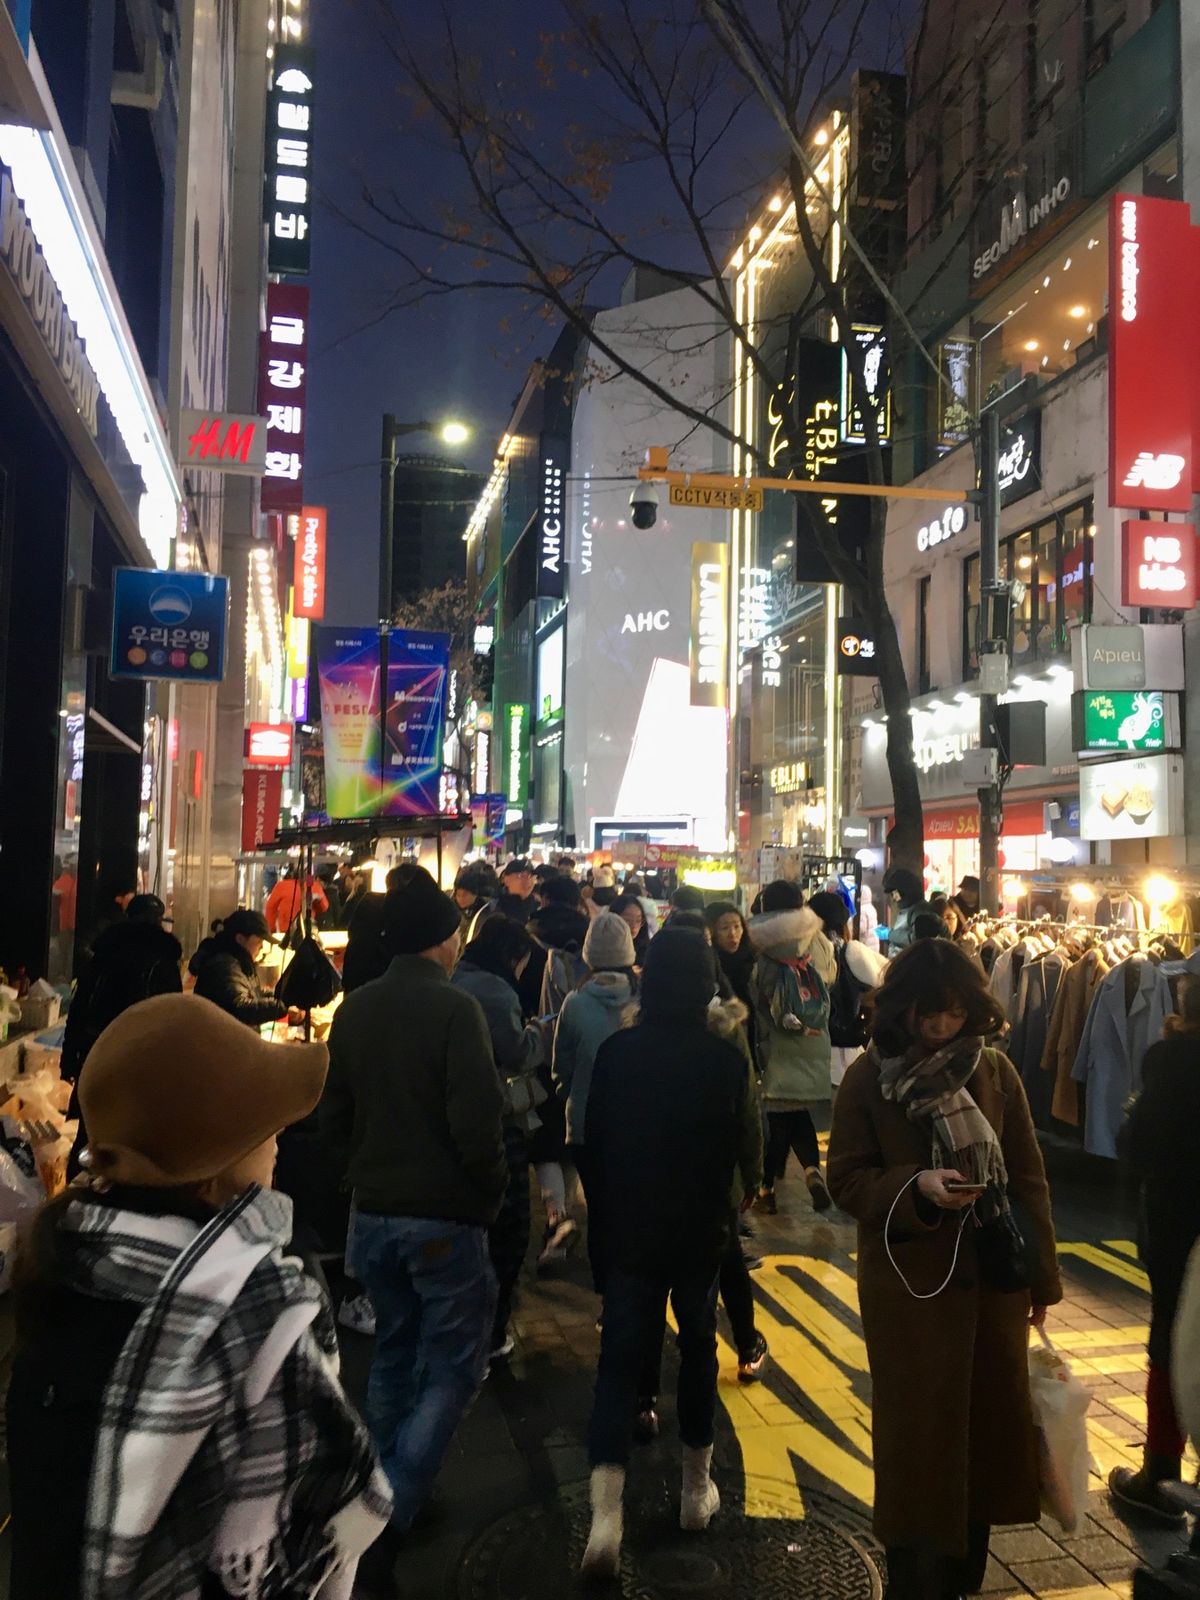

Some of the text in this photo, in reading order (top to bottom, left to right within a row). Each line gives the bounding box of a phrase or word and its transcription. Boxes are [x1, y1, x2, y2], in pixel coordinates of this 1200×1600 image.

[1122, 241, 1139, 322] balance
[265, 315, 304, 480] 금강제화
[188, 418, 256, 464] H&M
[542, 518, 561, 574] AHC
[128, 625, 210, 650] 우리은행
[621, 608, 670, 634] AHC
[699, 563, 724, 684] LANEIGE
